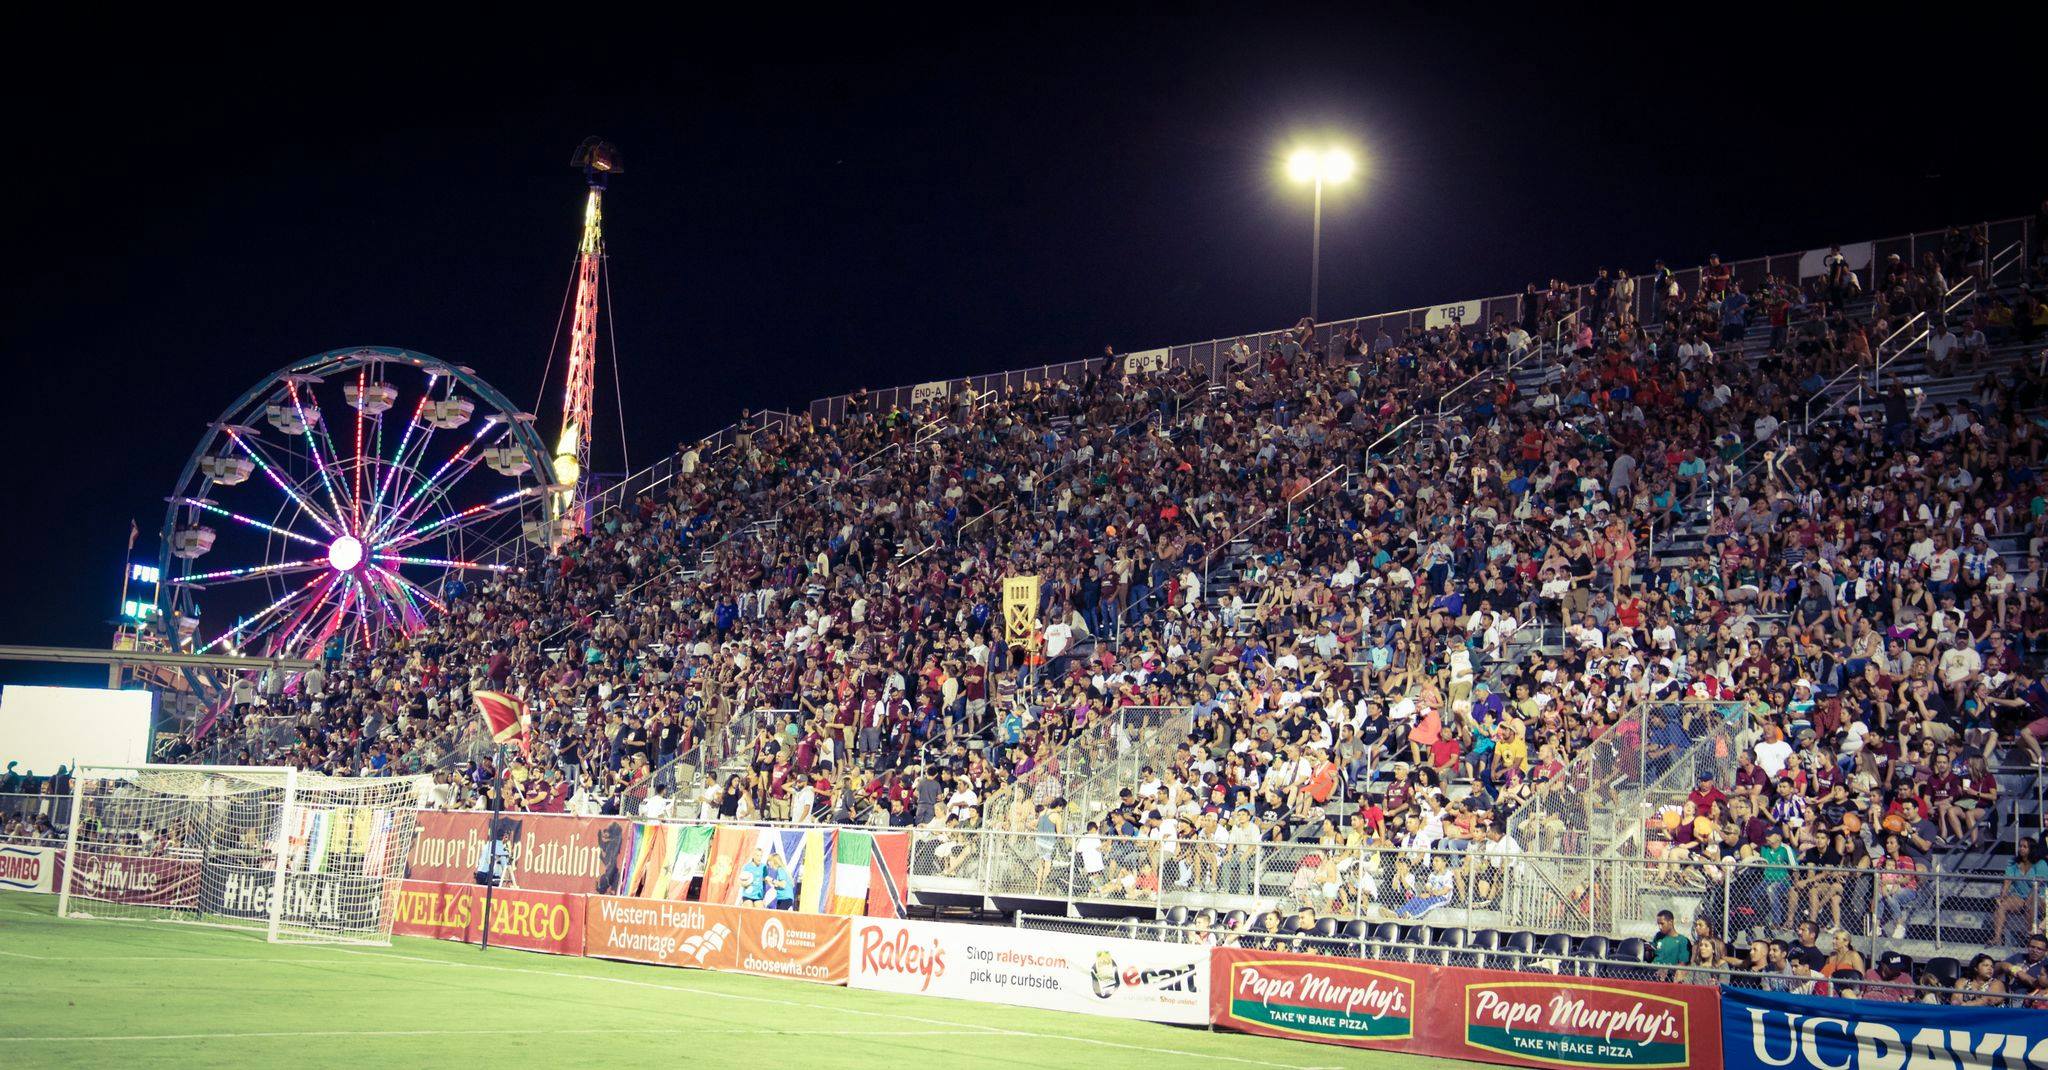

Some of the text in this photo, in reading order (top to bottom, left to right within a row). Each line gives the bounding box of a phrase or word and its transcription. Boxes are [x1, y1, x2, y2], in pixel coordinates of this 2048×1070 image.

[1441, 306, 1465, 318] TBB
[915, 387, 942, 398] END-A
[413, 826, 466, 868] Tower
[525, 832, 601, 877] Battalion
[0, 856, 40, 880] BIMBO
[391, 889, 570, 941] WELLS FARGO
[601, 899, 705, 930] Western Health
[608, 926, 676, 959] Advantage
[967, 946, 994, 964] Shop
[744, 953, 829, 978] choosewha.com
[860, 925, 945, 992] Raley's
[970, 969, 1062, 991] pick up curbside.
[1239, 967, 1294, 1008] Papa
[1269, 1010, 1294, 1022] TAKE
[1308, 1014, 1335, 1027] BAKE
[1339, 1019, 1368, 1031] PIZZA
[1476, 990, 1542, 1034] Papa
[1513, 1036, 1543, 1049] TAKE
[1561, 1041, 1594, 1054] BAKE
[1598, 1045, 1633, 1058] PIZZA
